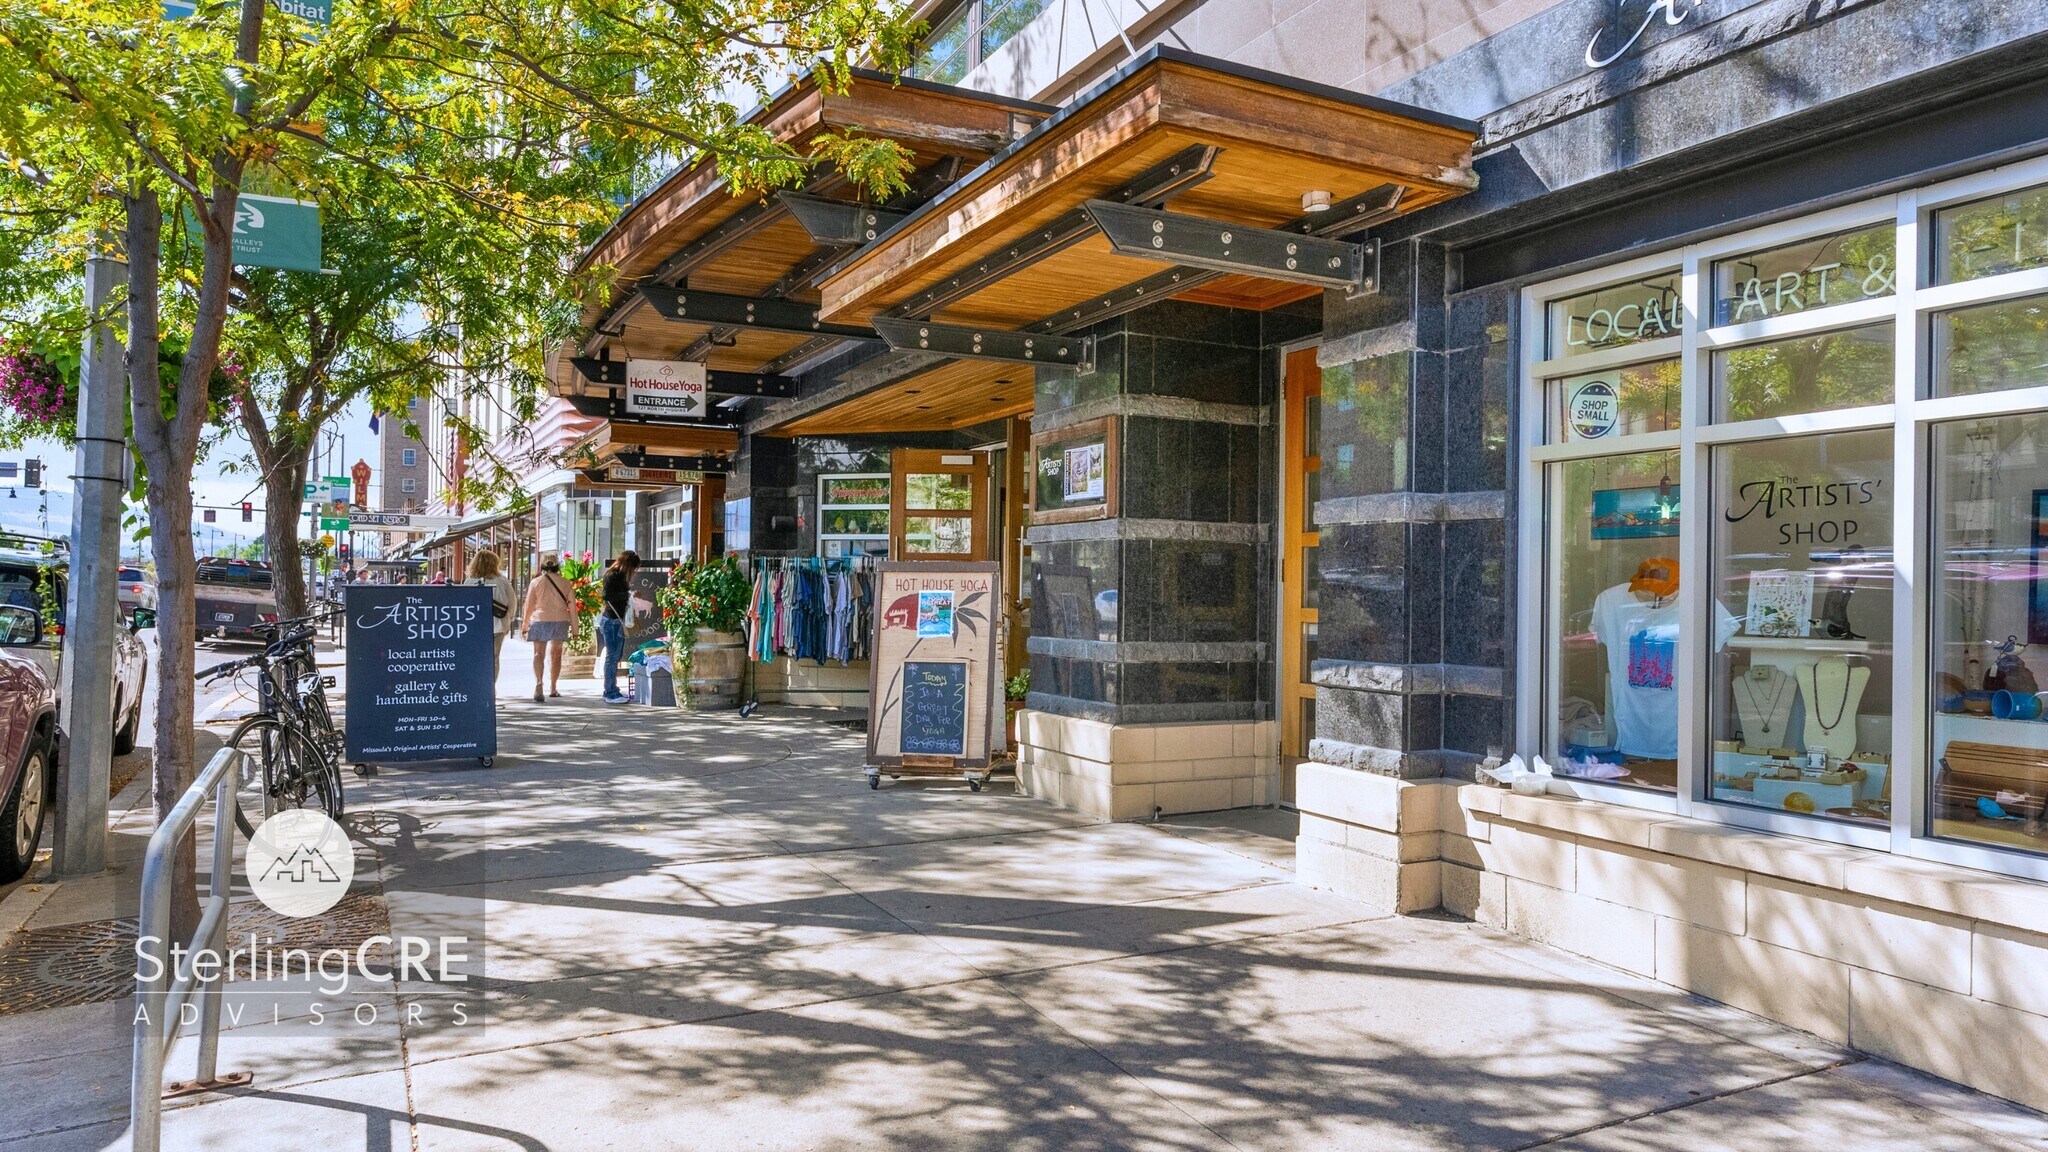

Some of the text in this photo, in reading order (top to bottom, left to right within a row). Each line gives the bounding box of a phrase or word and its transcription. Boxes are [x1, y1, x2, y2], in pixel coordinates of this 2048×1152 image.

[280, 0, 326, 20] bitat
[236, 245, 261, 253] TRUST
[1567, 254, 1896, 346] LOCAL ART &
[630, 377, 648, 389] Hot
[638, 396, 686, 407] ENTRANCE
[1582, 400, 1609, 410] SHOP
[1577, 410, 1609, 421] SMALL
[1780, 475, 1799, 484] The
[1779, 520, 1858, 545] SHOP
[895, 578, 988, 591] HOT HOUSE YOGA
[406, 596, 423, 604] The
[356, 602, 480, 629] ARTISTS'
[407, 623, 468, 640] SHOP
[388, 648, 455, 660] local artists
[387, 661, 456, 674] cooperative
[394, 680, 450, 695] gallery &
[936, 689, 943, 698] A
[375, 692, 468, 706] handmade gifts
[362, 746, 392, 754] Missoula's
[393, 745, 418, 753] Original
[442, 742, 477, 750] Cooperative
